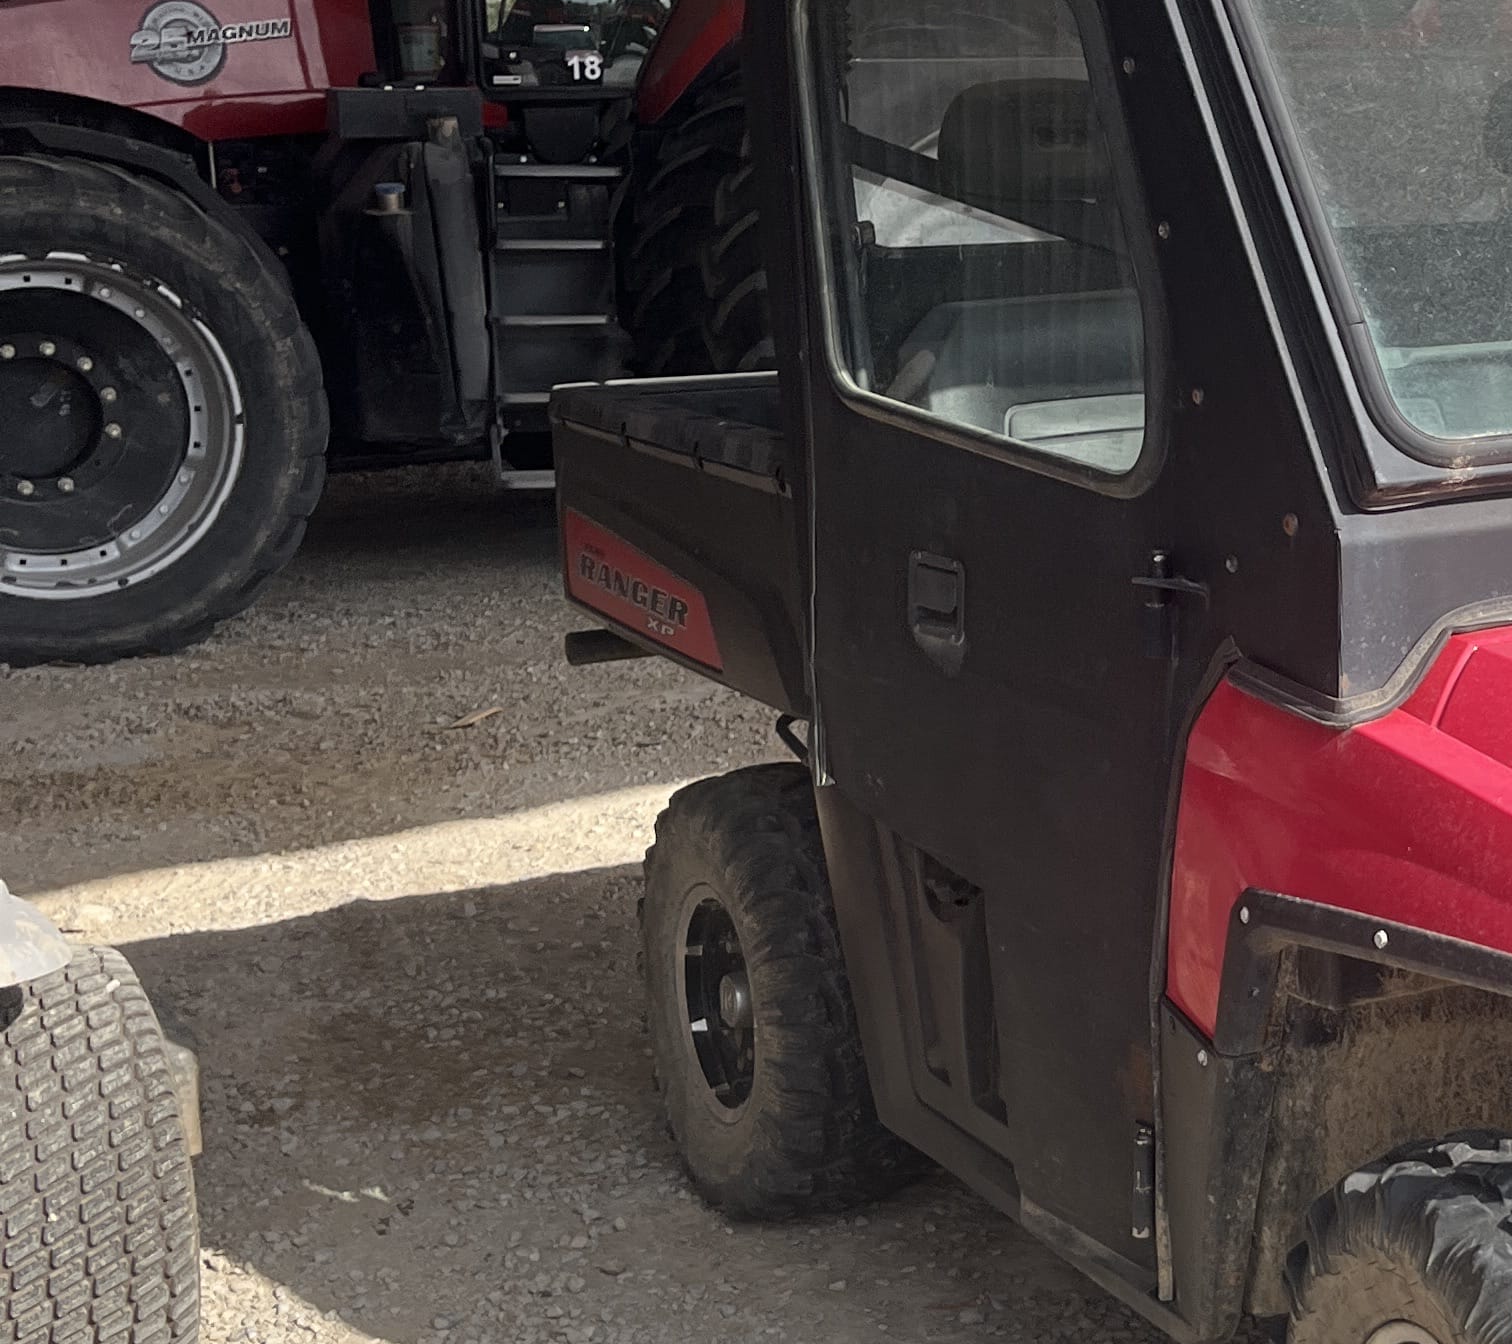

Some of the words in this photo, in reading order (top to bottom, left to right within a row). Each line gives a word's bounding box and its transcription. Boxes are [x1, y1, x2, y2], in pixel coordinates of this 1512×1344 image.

[186, 19, 290, 44] MAGNUM
[567, 55, 601, 81] 18
[579, 553, 689, 627] RANGER
